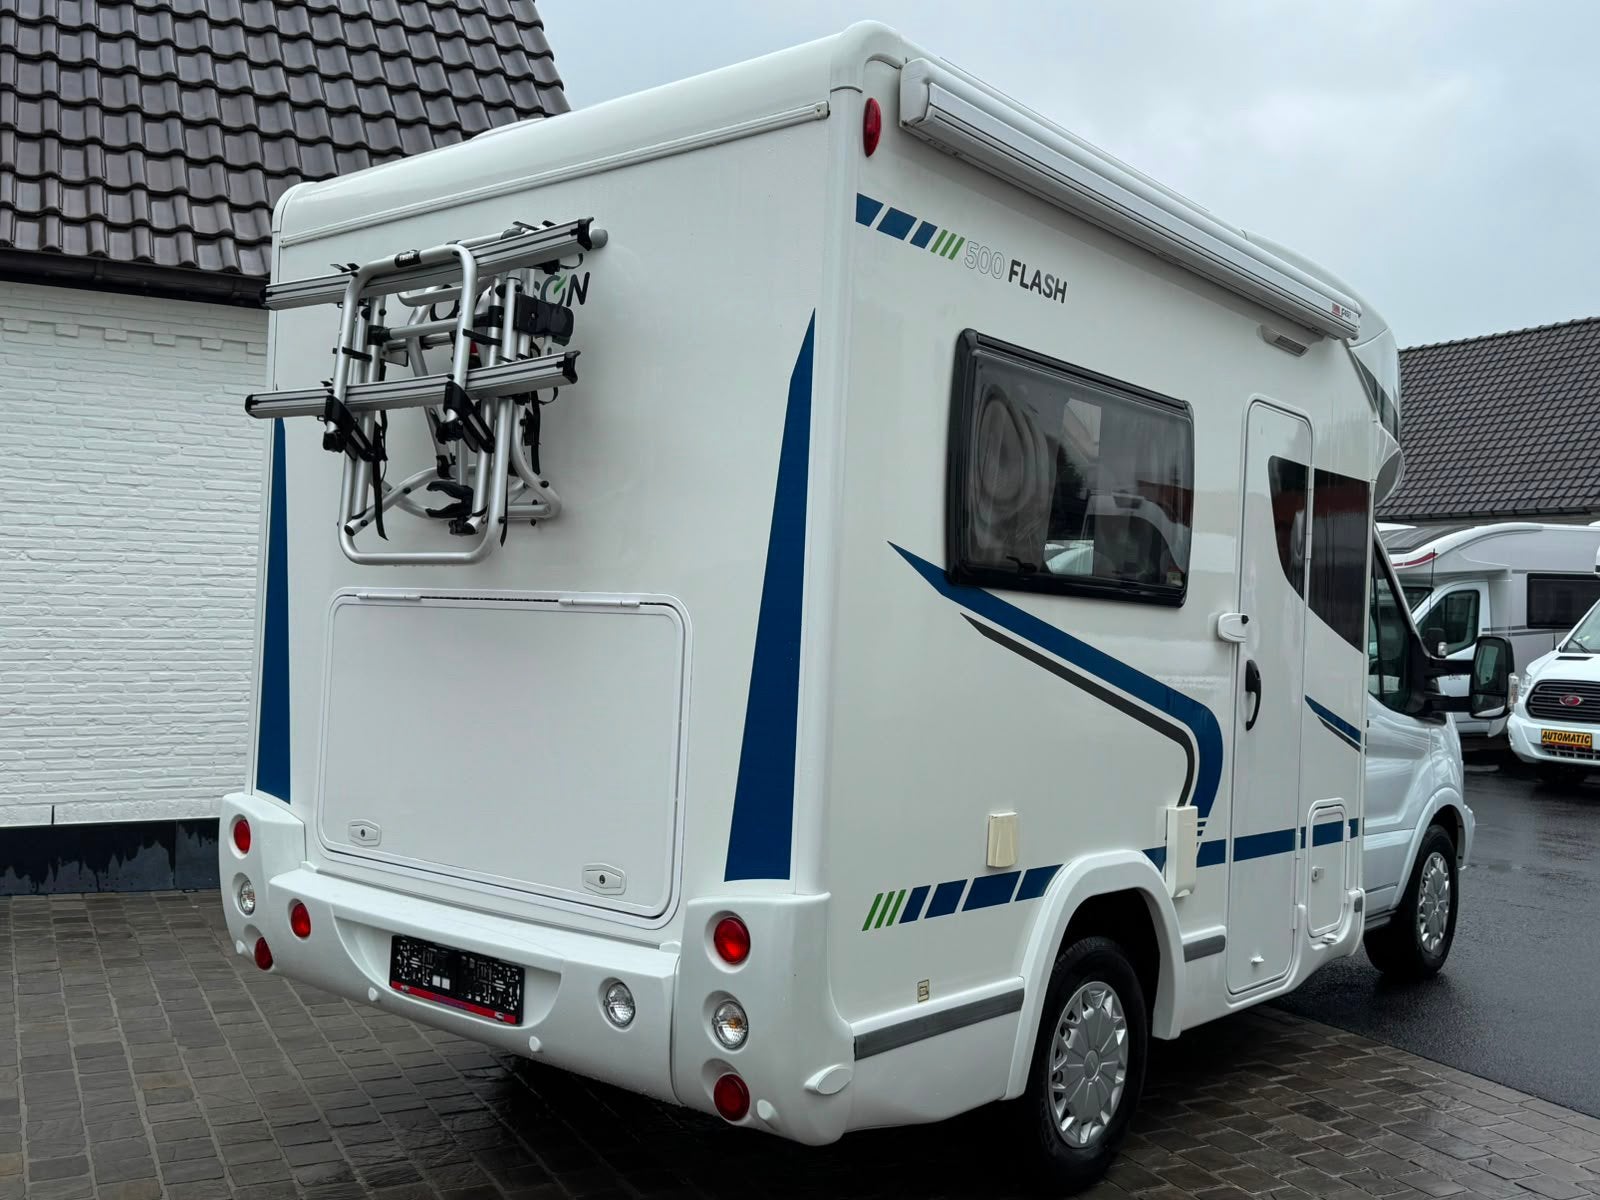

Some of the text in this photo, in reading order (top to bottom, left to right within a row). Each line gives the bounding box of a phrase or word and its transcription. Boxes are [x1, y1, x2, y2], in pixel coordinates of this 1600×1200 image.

[964, 241, 1068, 304] 500 FLASH
[1542, 731, 1590, 744] AUTOMATIC
